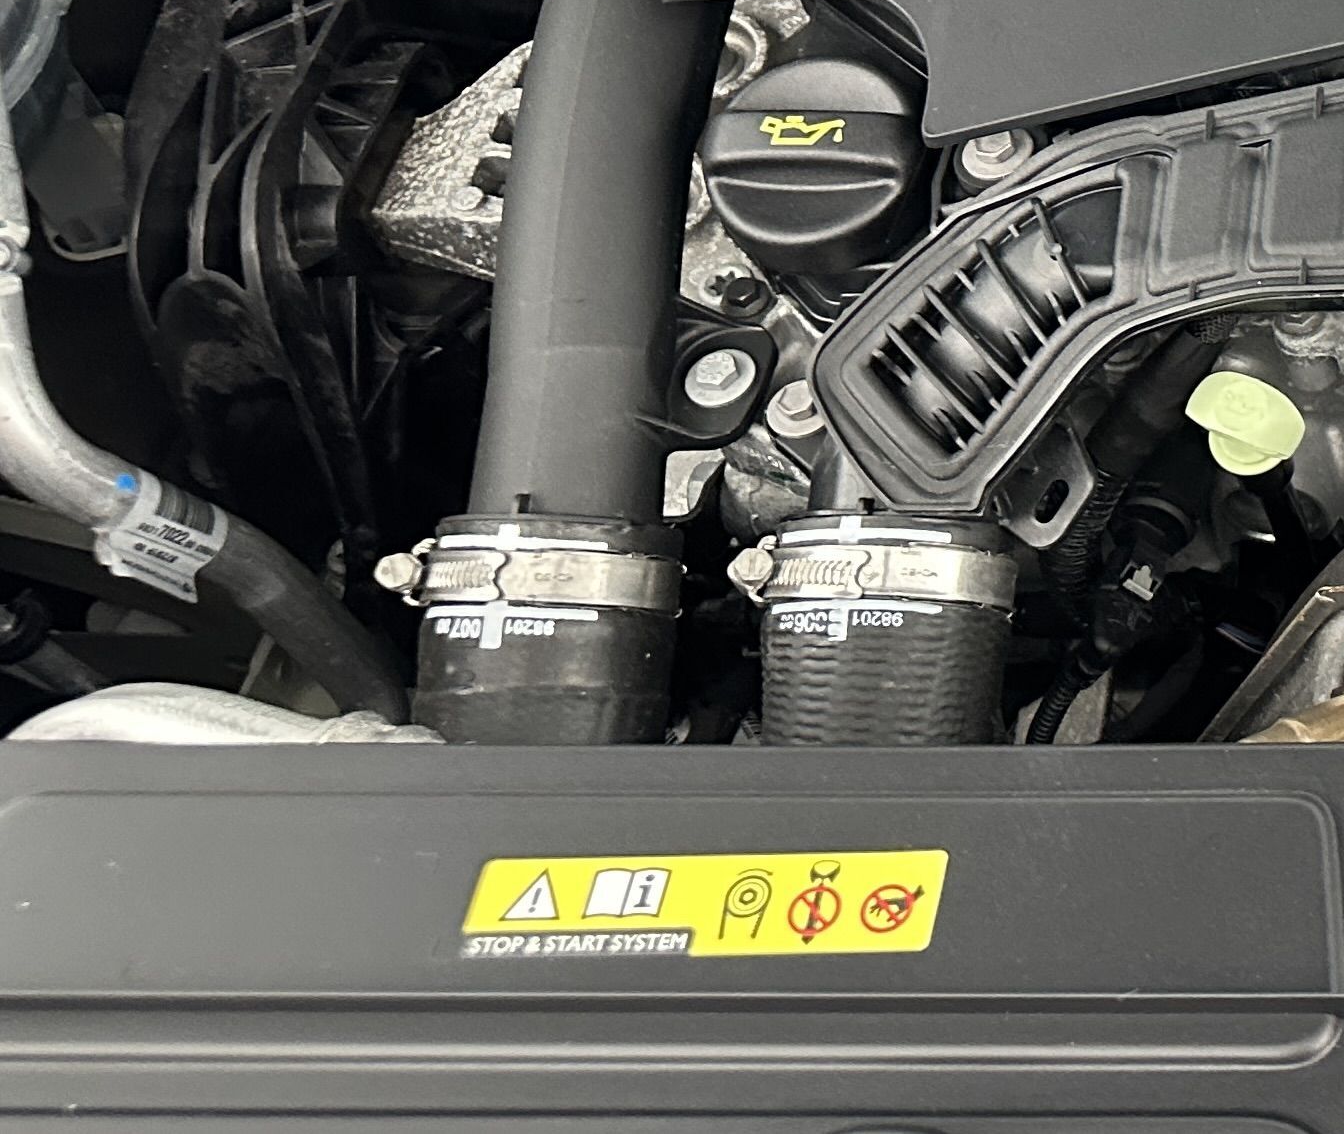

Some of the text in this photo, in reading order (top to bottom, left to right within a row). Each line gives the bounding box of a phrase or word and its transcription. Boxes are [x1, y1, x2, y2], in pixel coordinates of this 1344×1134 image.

[851, 610, 904, 628] 98201
[470, 932, 689, 954] STOP & START SYSTEM
